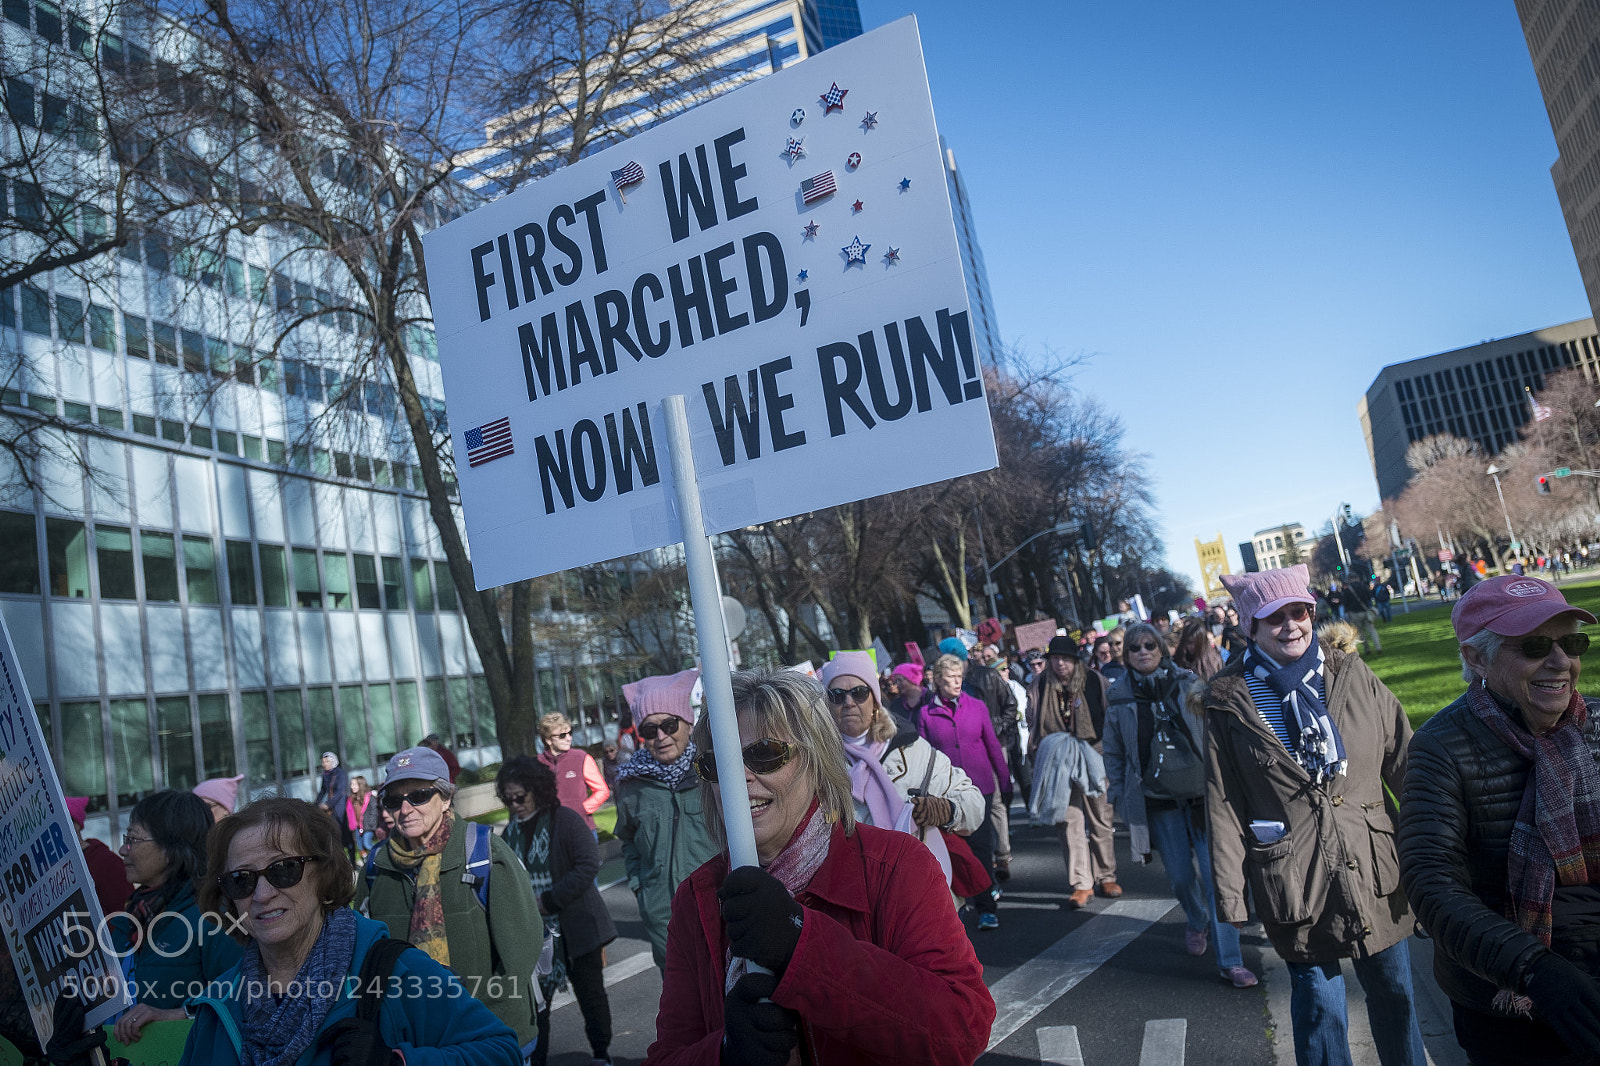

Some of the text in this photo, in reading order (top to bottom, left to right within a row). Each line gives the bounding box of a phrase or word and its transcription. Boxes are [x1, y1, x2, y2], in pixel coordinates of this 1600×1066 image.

[471, 127, 758, 321] FIRST WE
[518, 231, 811, 402] MARCHED,
[534, 307, 982, 514] NOW WE RUN!
[17, 706, 55, 815] PARENTHOOD
[3, 822, 70, 904] FOR HER
[13, 790, 46, 846] CHANGE
[49, 860, 76, 901] RIGHTS
